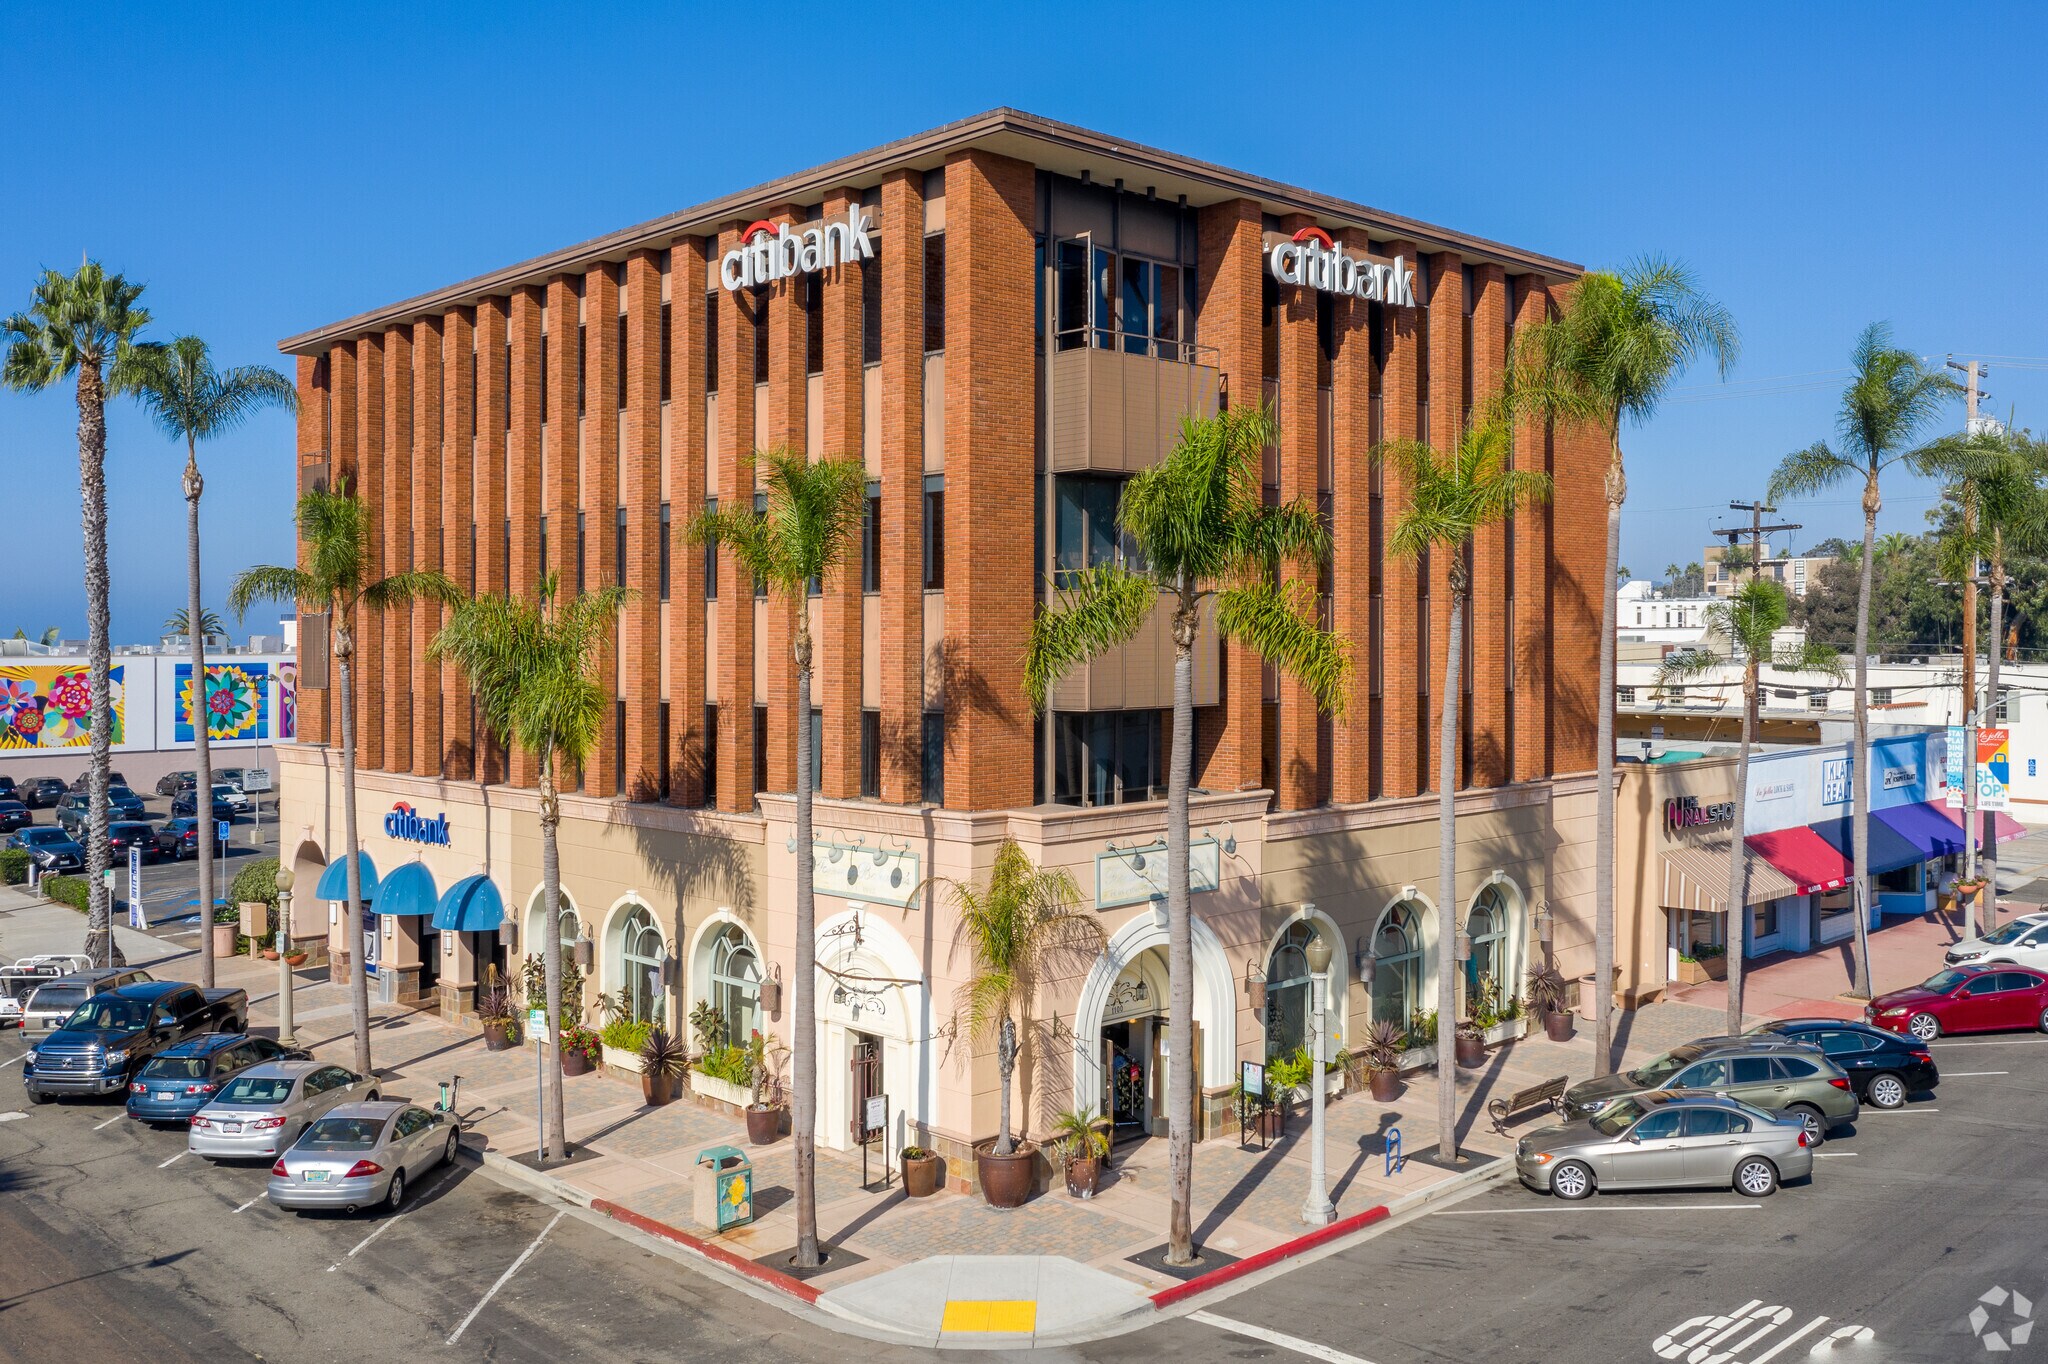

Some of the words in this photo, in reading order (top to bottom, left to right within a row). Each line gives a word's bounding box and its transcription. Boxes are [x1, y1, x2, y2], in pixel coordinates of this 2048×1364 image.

[721, 203, 874, 291] citibank
[1271, 237, 1415, 307] citibank
[1826, 781, 1852, 802] REALT
[384, 808, 450, 846] citibank
[1112, 1005, 1123, 1014] 1100
